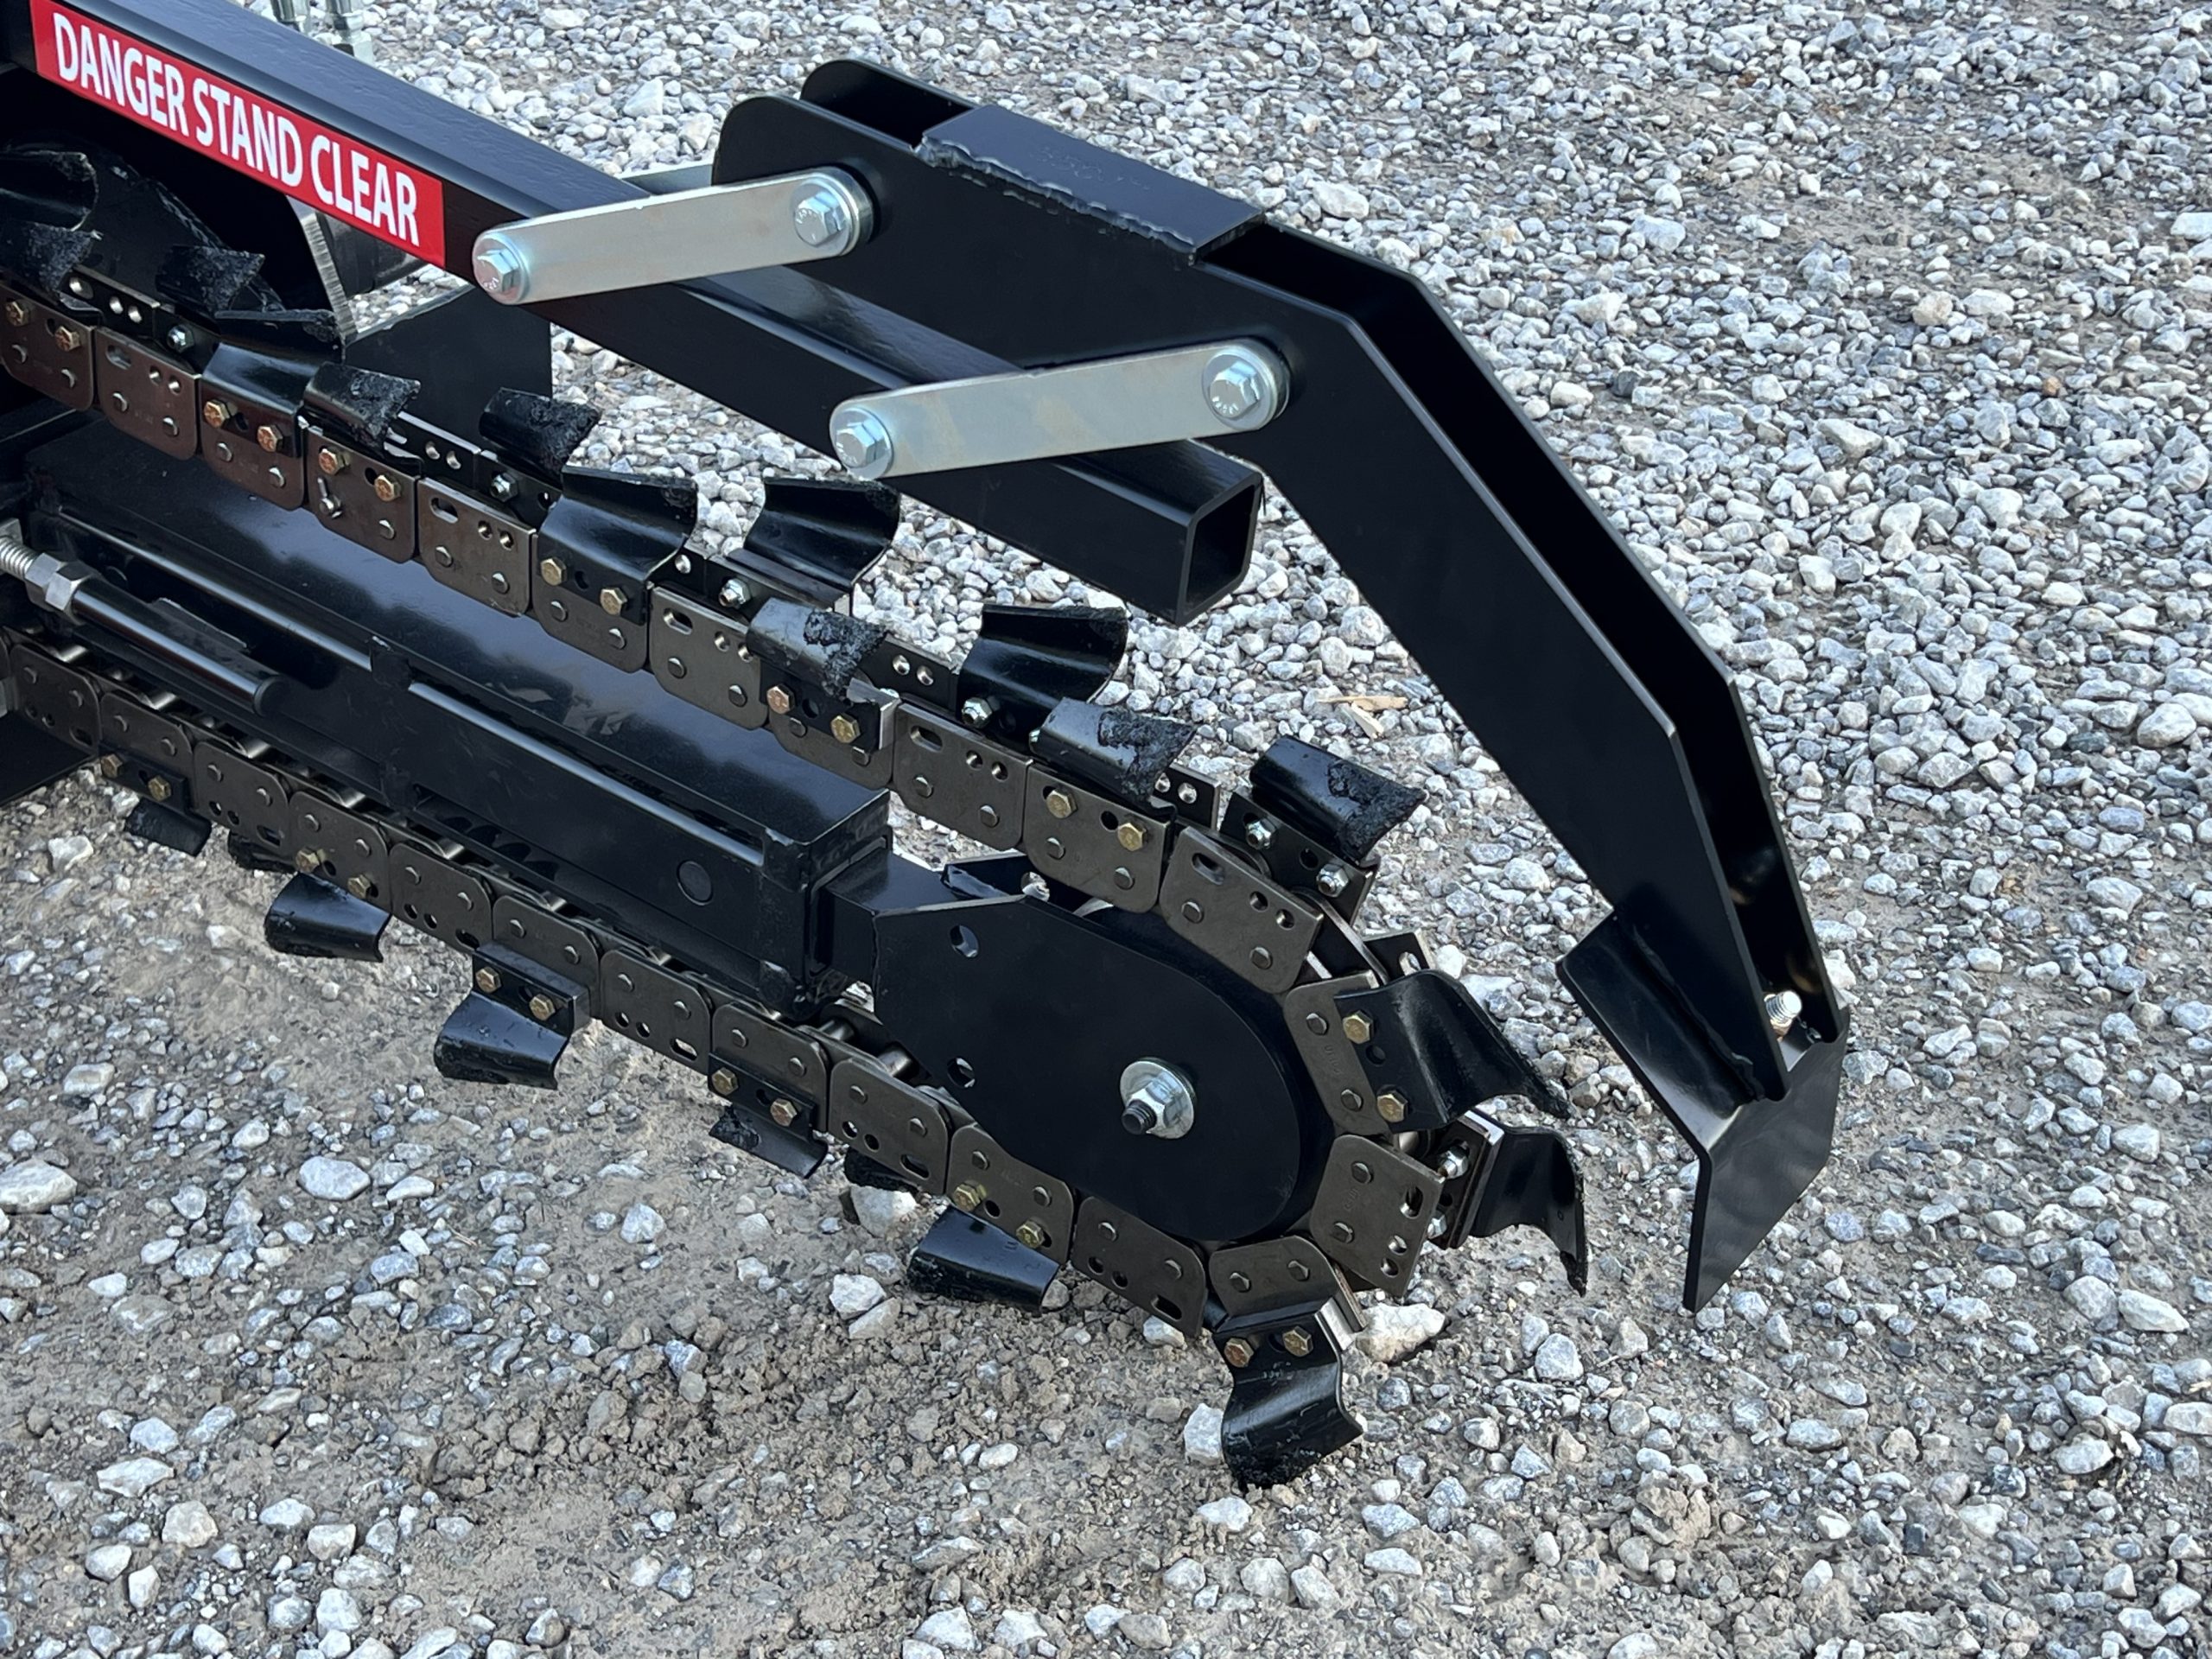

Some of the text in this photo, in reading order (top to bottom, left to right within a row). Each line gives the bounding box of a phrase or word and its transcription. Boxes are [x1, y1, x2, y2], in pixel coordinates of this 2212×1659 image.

[53, 12, 420, 246] DANGER STAND CLEAR
